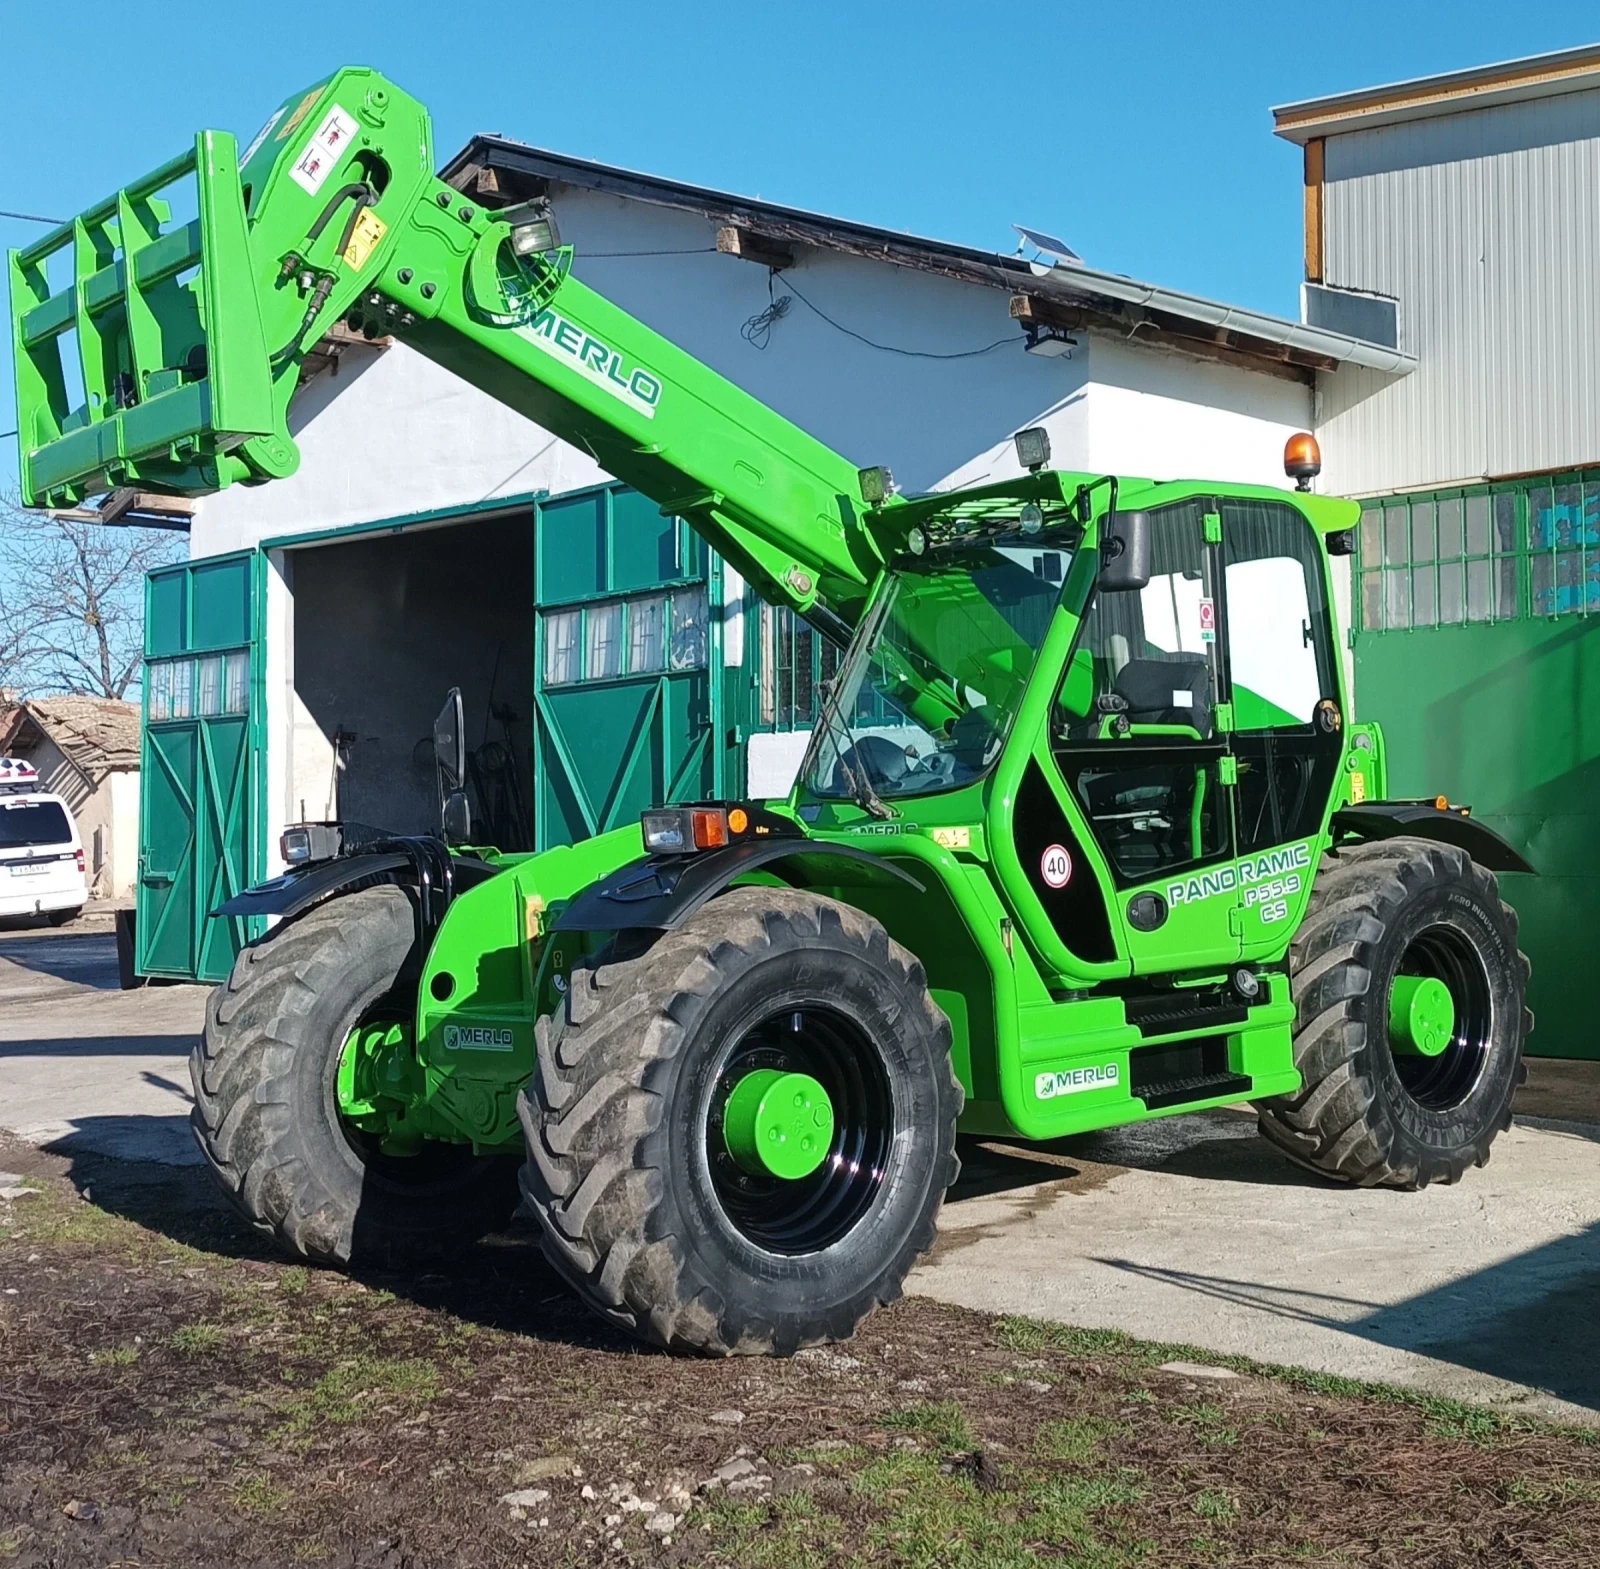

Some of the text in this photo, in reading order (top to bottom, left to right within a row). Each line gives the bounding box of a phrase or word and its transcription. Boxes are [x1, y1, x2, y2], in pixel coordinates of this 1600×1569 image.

[517, 299, 661, 406] MERLO
[1047, 856, 1066, 876] 40
[1168, 845, 1309, 905] PANORAMIC
[1245, 875, 1300, 906] P55.9
[1447, 892, 1471, 908] AGRO
[1261, 902, 1287, 923] CS
[460, 1027, 513, 1045] MERLO
[1055, 1063, 1118, 1089] MERLO
